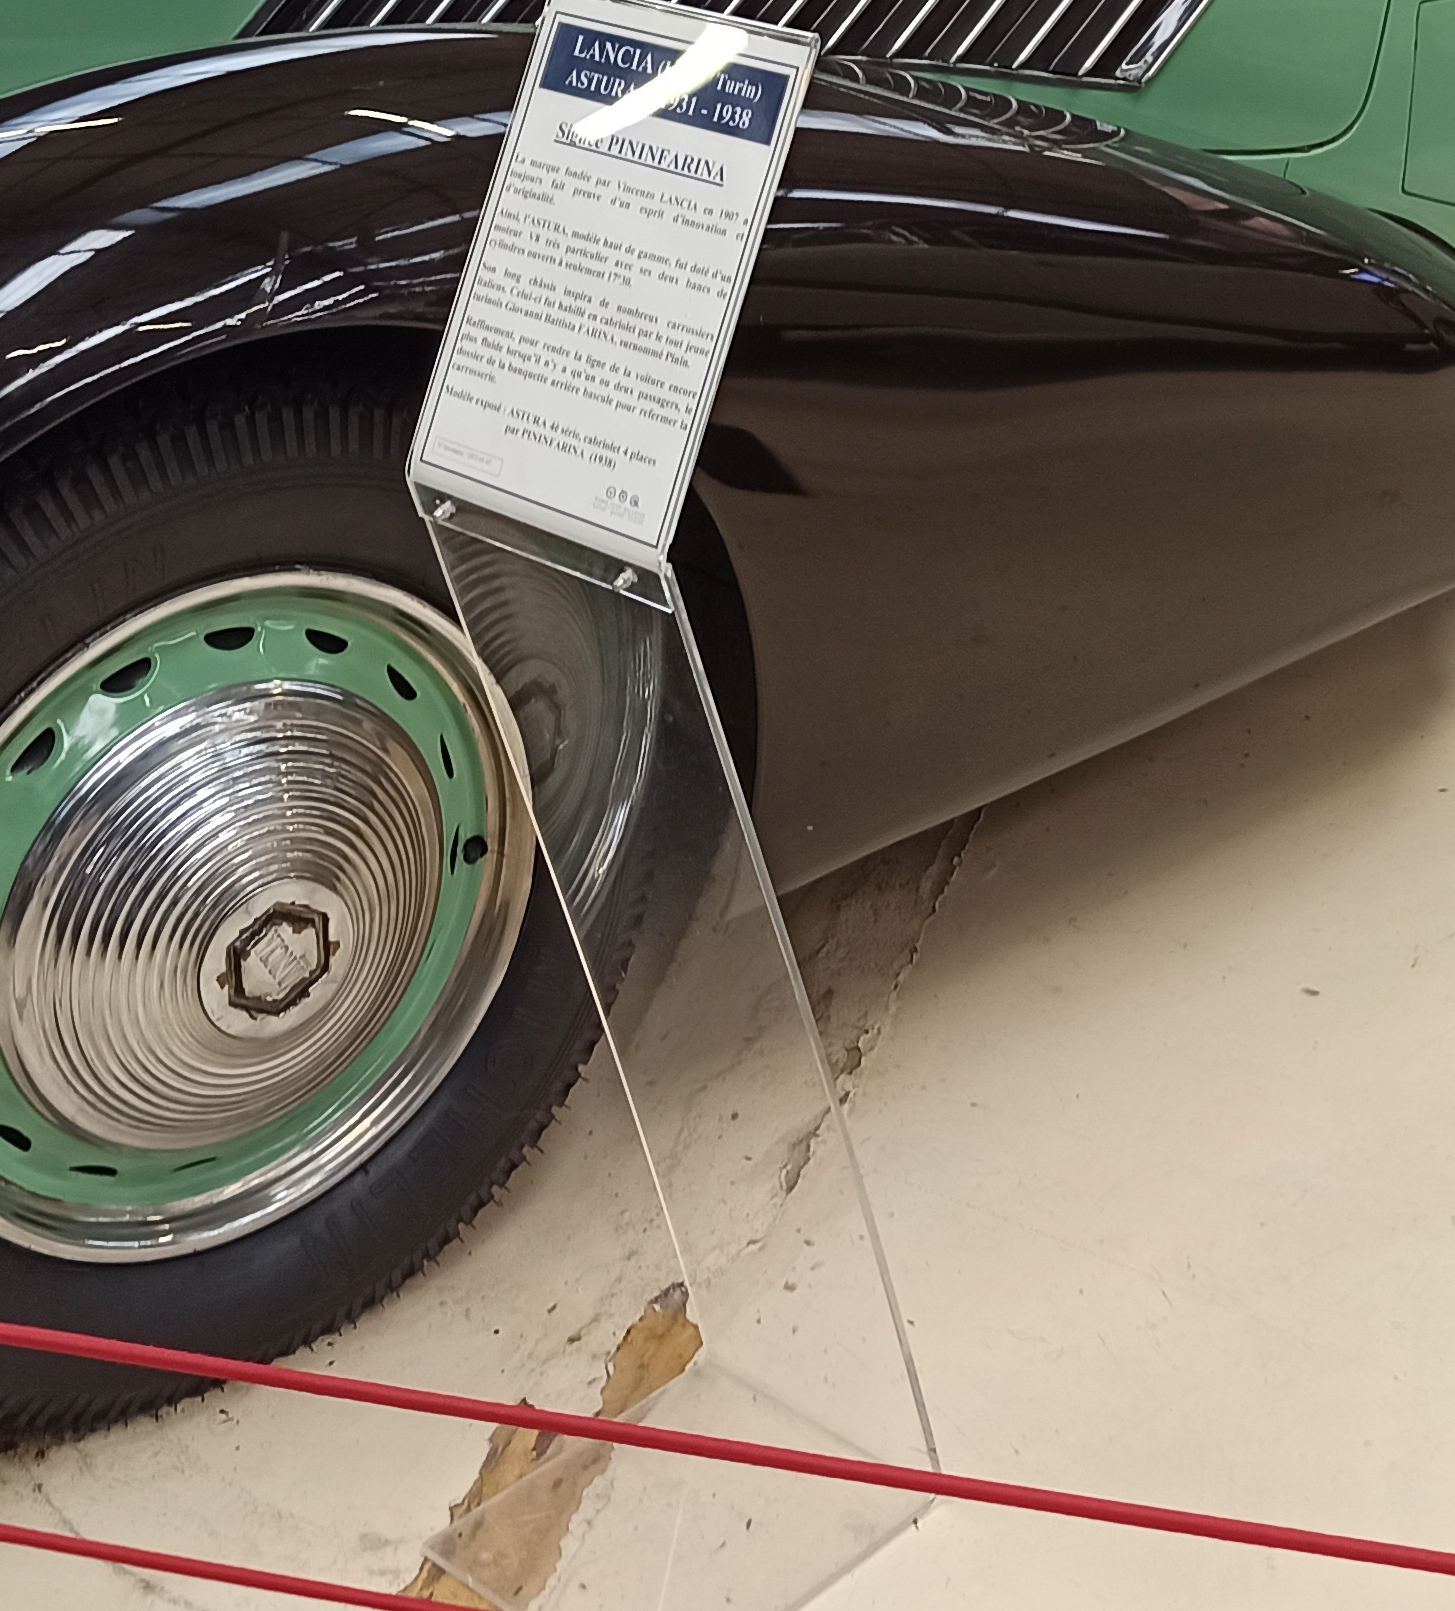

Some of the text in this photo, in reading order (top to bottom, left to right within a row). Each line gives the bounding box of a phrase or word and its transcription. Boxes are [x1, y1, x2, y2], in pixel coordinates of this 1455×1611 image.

[572, 34, 654, 75] LANCIA
[700, 107, 708, 115] -
[712, 101, 753, 130] 1938
[513, 150, 526, 165] La
[528, 157, 561, 175] marque
[563, 164, 592, 183] fondée
[593, 176, 612, 188] par
[616, 178, 656, 201] Vincenzo
[658, 190, 698, 213] LANCIA
[701, 206, 714, 217] en
[718, 207, 740, 222] 1907
[607, 135, 725, 183] PININFARINA
[508, 167, 745, 243] toujours fait preuve d'un esprit d'innovation et
[487, 237, 526, 256] cylindres
[525, 248, 557, 266] ouverts
[563, 259, 606, 280] seulement
[492, 222, 524, 238] moteur
[528, 229, 541, 244] V8
[563, 243, 610, 265] particulier
[612, 258, 634, 273] avec
[638, 265, 652, 278] ses
[656, 269, 679, 286] deux
[684, 276, 711, 295] bancs
[715, 286, 728, 301] de
[569, 228, 601, 246] modèle
[601, 235, 623, 252] haut
[623, 242, 636, 256] de
[673, 256, 689, 271] fut
[688, 261, 710, 278] doté
[710, 267, 732, 285] d'un
[471, 290, 503, 309] turinois
[503, 299, 544, 322] Giovanni
[542, 311, 576, 333] Battista
[480, 259, 497, 274] Son
[502, 265, 522, 285] long
[562, 284, 593, 304] inspira
[597, 296, 610, 310] de
[615, 303, 659, 325] nombreux
[665, 319, 715, 343] carrossiers
[508, 284, 543, 305] Celui-ci
[542, 294, 557, 309] fut
[586, 311, 598, 322] en
[598, 314, 637, 335] cabriolet
[636, 326, 654, 340] par
[653, 329, 664, 344] le
[663, 333, 684, 350] tout
[682, 340, 711, 359] jeune
[455, 344, 688, 432] dossier de la banquette arrière bascule pour refermer la
[458, 330, 478, 345] plus
[479, 335, 504, 353] fluide
[504, 343, 542, 366] lorsqu'il
[569, 367, 596, 384] qu'un
[597, 376, 611, 388] ou
[612, 379, 634, 397] deux
[683, 401, 693, 416] le
[516, 333, 540, 348] pour
[541, 341, 571, 359] rendre
[572, 348, 583, 363] la
[584, 352, 607, 370] ligne
[607, 361, 621, 375] de
[621, 364, 632, 378] la
[634, 370, 666, 389] voiture
[667, 382, 698, 400] encore
[444, 382, 475, 404] Modèle
[473, 396, 502, 414] exposé
[506, 406, 547, 429] ASTURA
[582, 433, 622, 455] cabriolet
[627, 448, 657, 467] places
[502, 423, 617, 471] par PININFARINA (1938)
